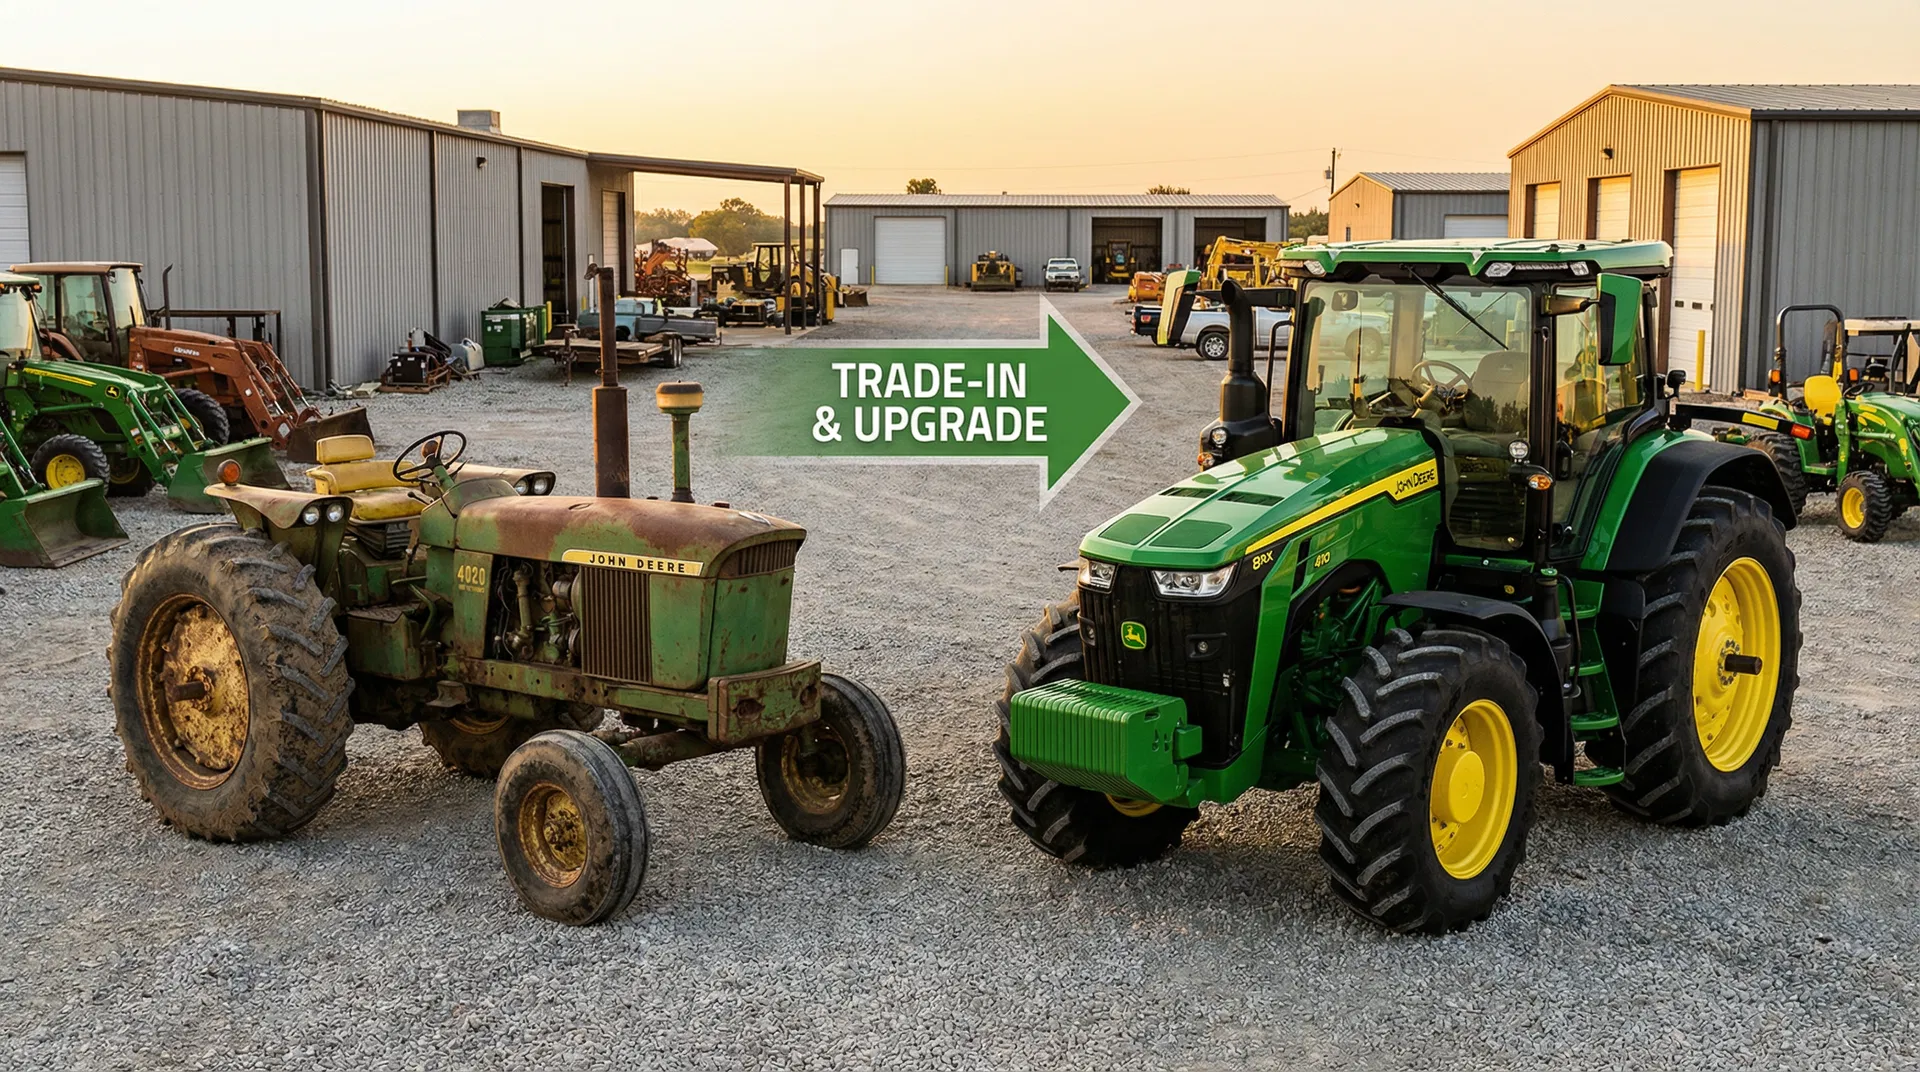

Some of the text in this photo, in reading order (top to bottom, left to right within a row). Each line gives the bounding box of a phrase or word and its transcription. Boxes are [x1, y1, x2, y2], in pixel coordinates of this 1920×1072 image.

[1413, 468, 1435, 487] DEERE
[589, 554, 685, 573] JOHN DEERE
[1252, 550, 1274, 571] 8RX
[457, 564, 486, 586] 4020
